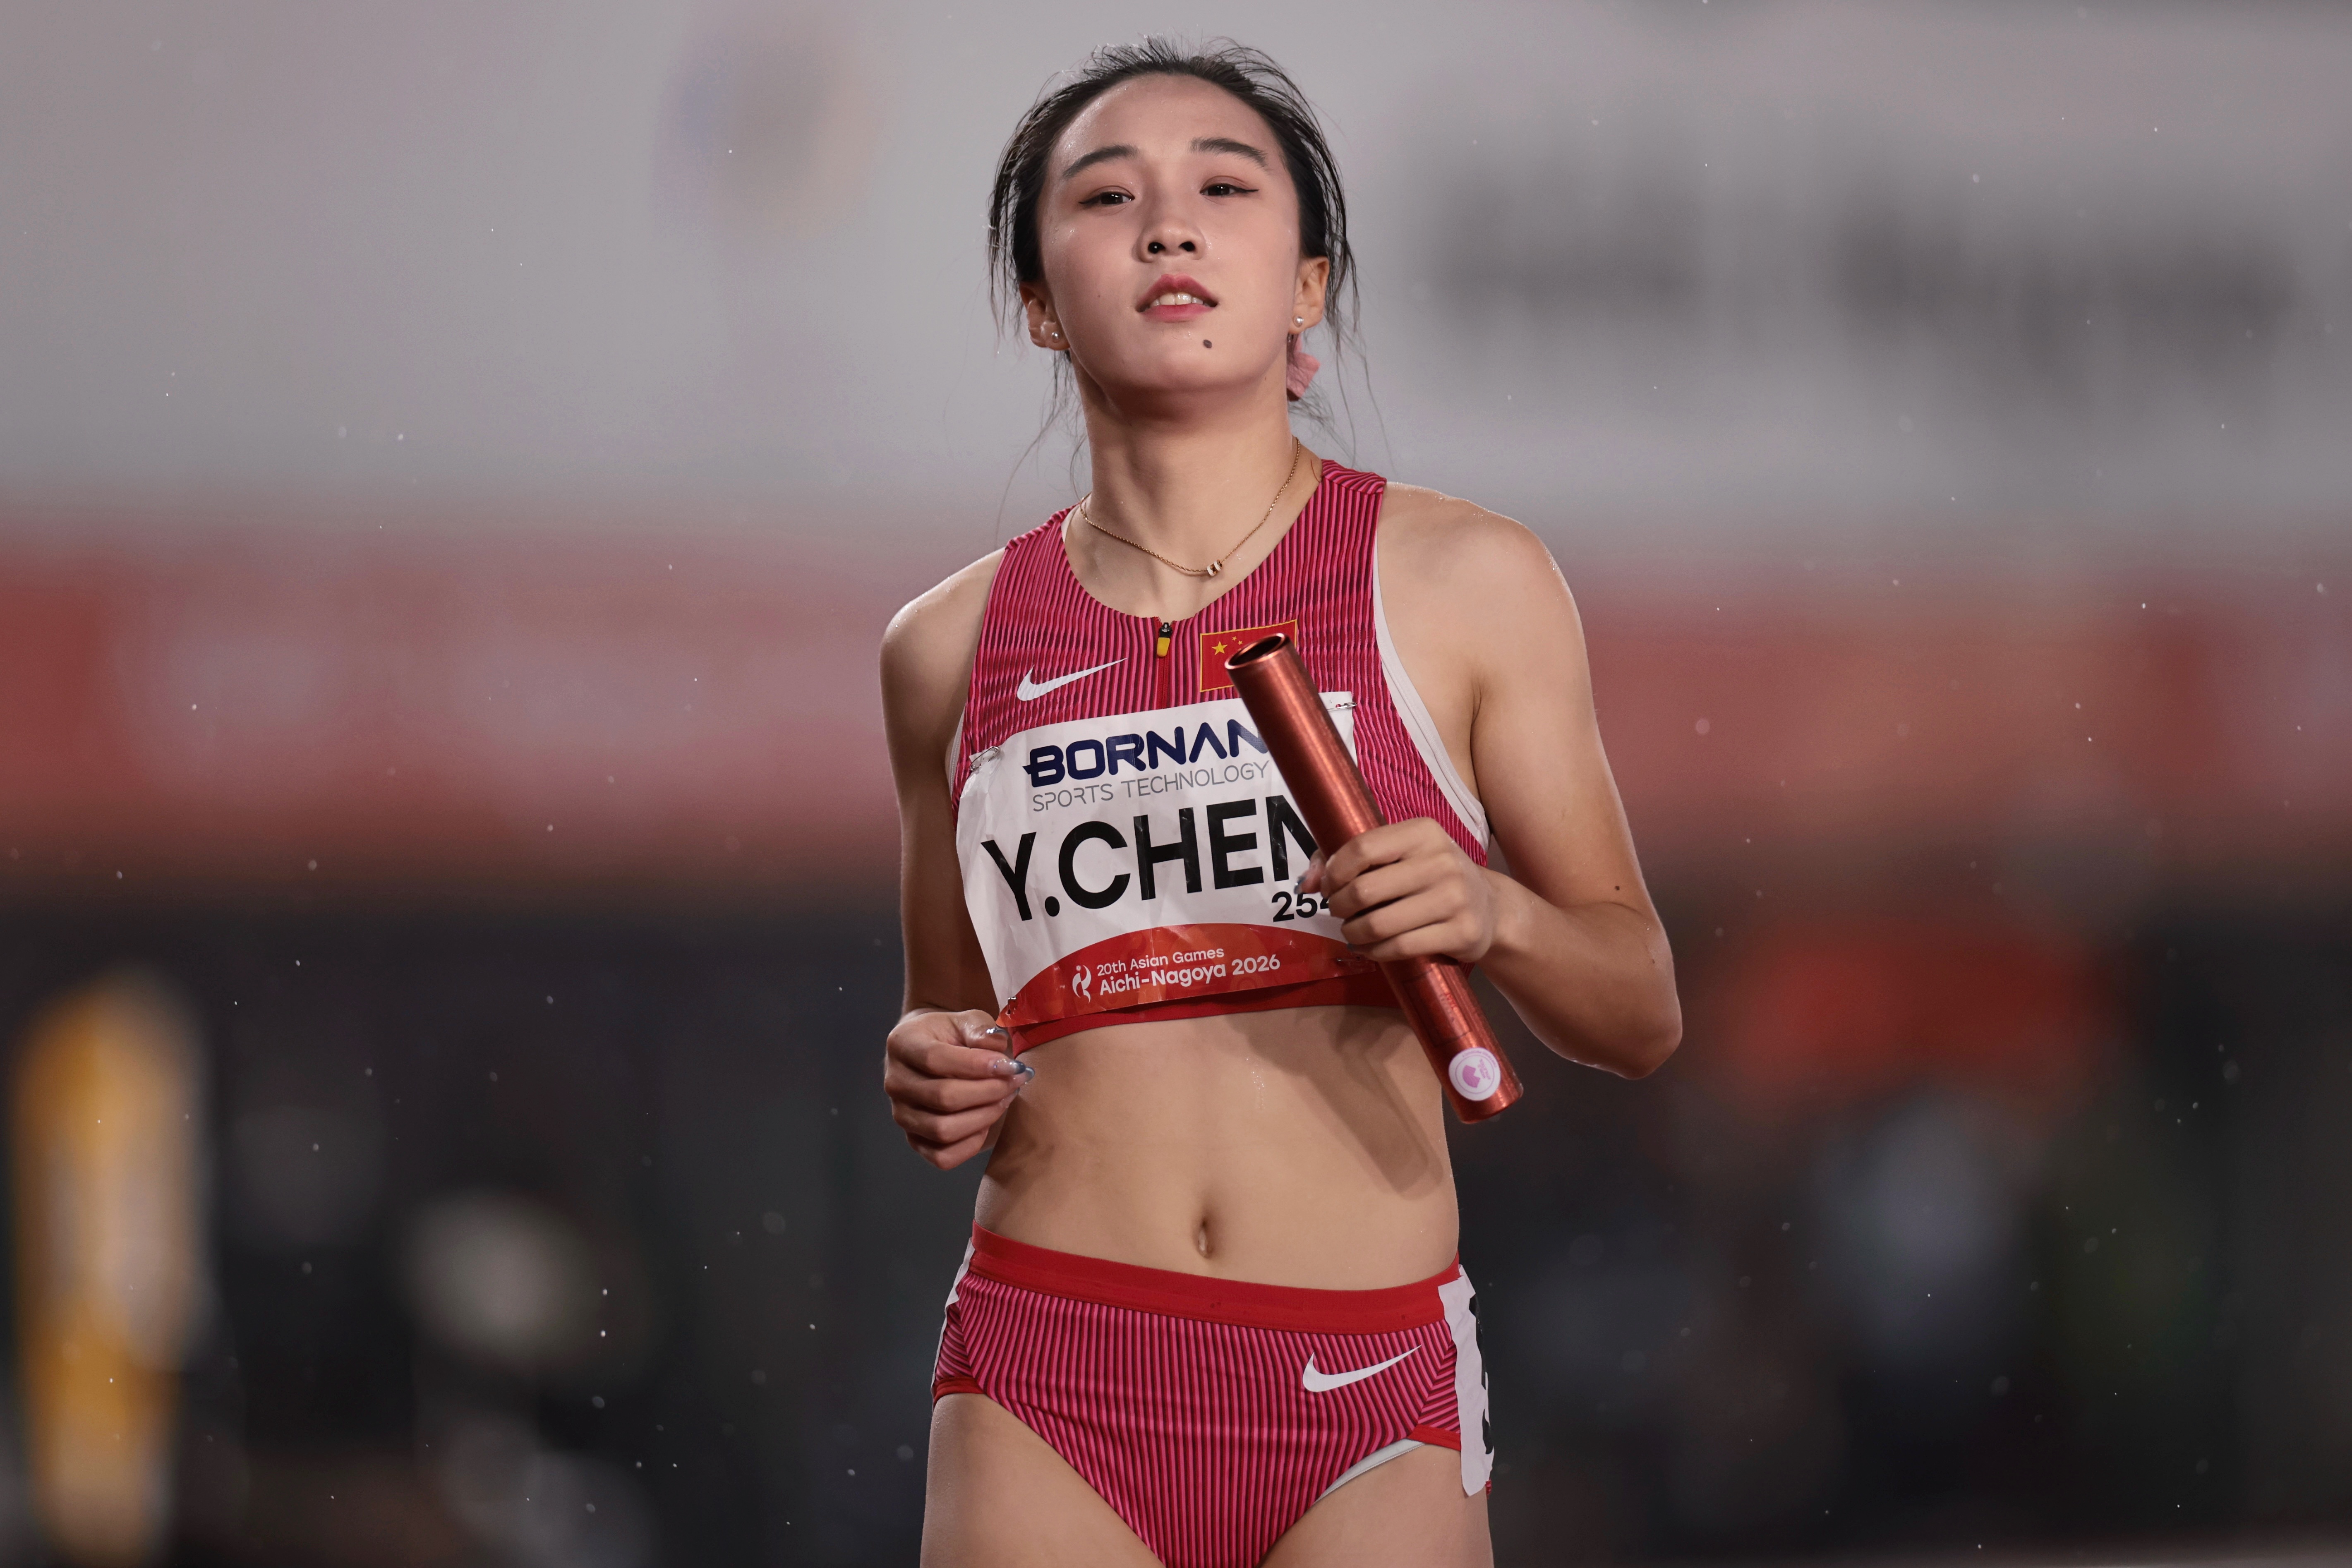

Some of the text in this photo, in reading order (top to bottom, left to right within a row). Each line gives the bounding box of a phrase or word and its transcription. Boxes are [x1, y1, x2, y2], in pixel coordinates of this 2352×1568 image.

[1022, 719, 1269, 787] BORNAN
[1033, 760, 1270, 812] SPORTS TECHNOLOGY
[981, 794, 1319, 921] Y.CHEN
[1097, 947, 1225, 977] 20th Asian Games
[1100, 954, 1280, 996] Aichi-Nagoya 2026
